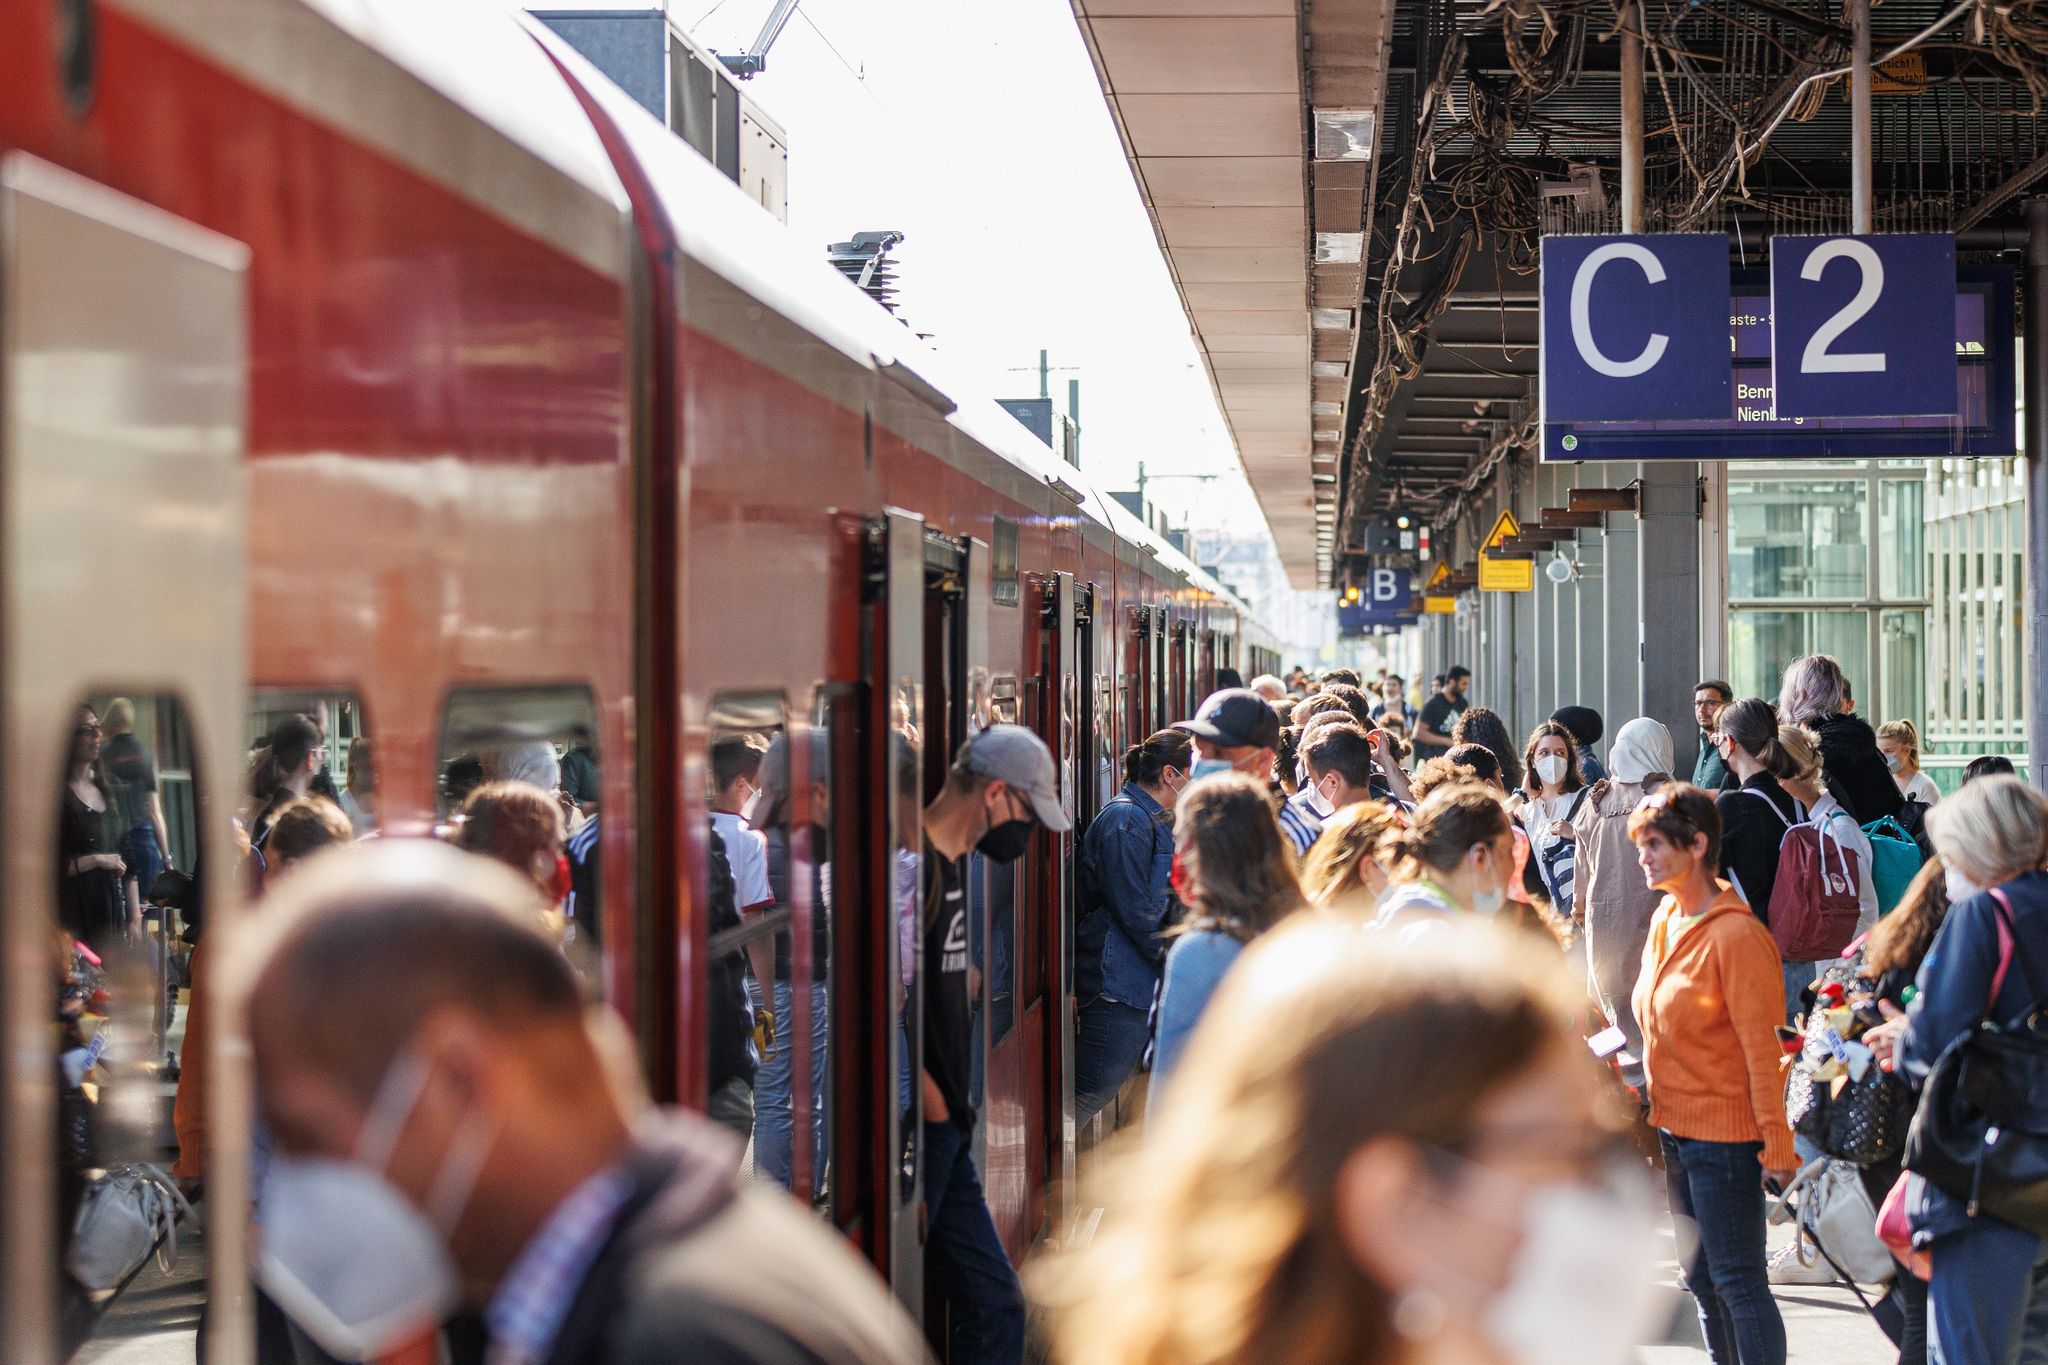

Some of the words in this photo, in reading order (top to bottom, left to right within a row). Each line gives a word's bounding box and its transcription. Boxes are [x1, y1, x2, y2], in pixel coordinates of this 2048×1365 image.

[1569, 242, 1670, 378] C
[1800, 238, 1887, 374] 2
[1737, 384, 1774, 399] Benn
[1373, 568, 1398, 602] B
